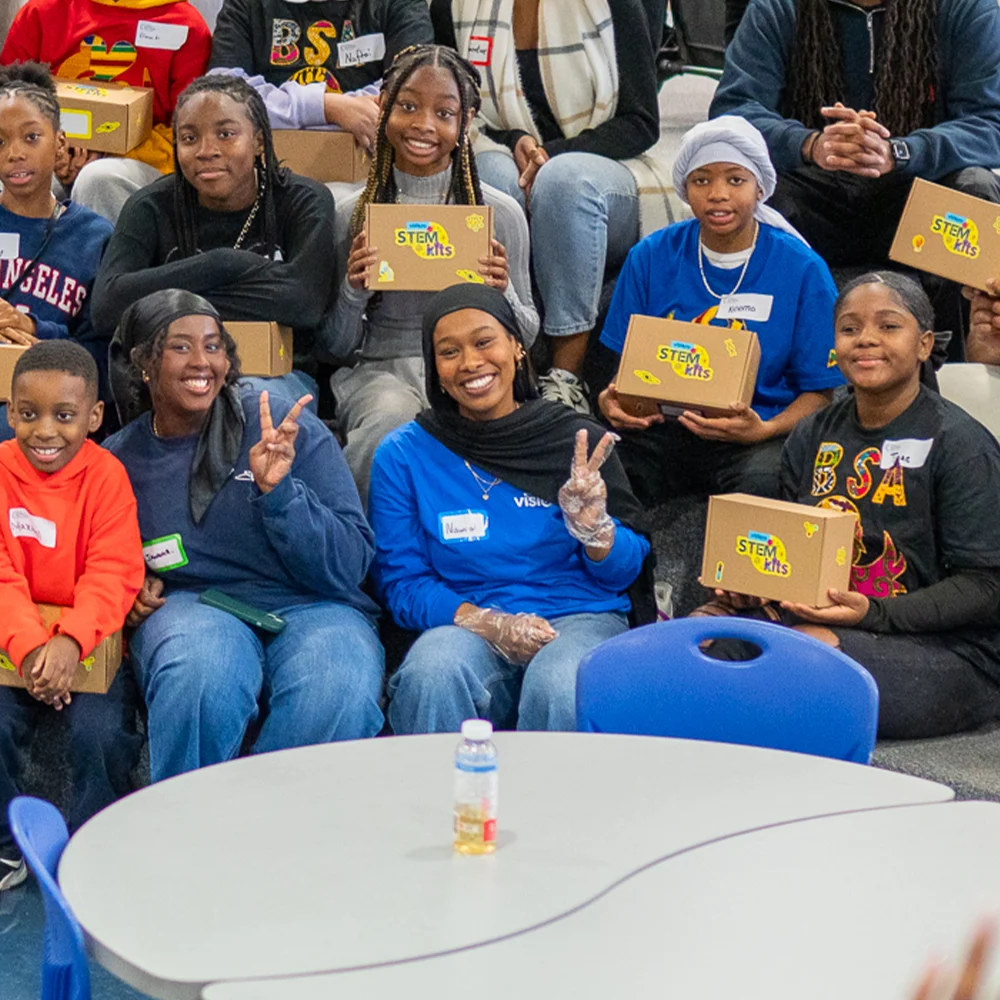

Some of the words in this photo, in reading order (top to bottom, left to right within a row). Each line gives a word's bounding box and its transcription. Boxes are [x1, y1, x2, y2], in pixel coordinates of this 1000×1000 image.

[397, 230, 438, 244] STEM
[933, 218, 971, 240] STEM
[426, 241, 453, 256] kits
[953, 238, 979, 257] kits
[659, 347, 701, 364] STEM
[684, 362, 711, 380] kits
[811, 440, 908, 507] BSA
[738, 538, 777, 558] STEM
[763, 555, 789, 576] kits
